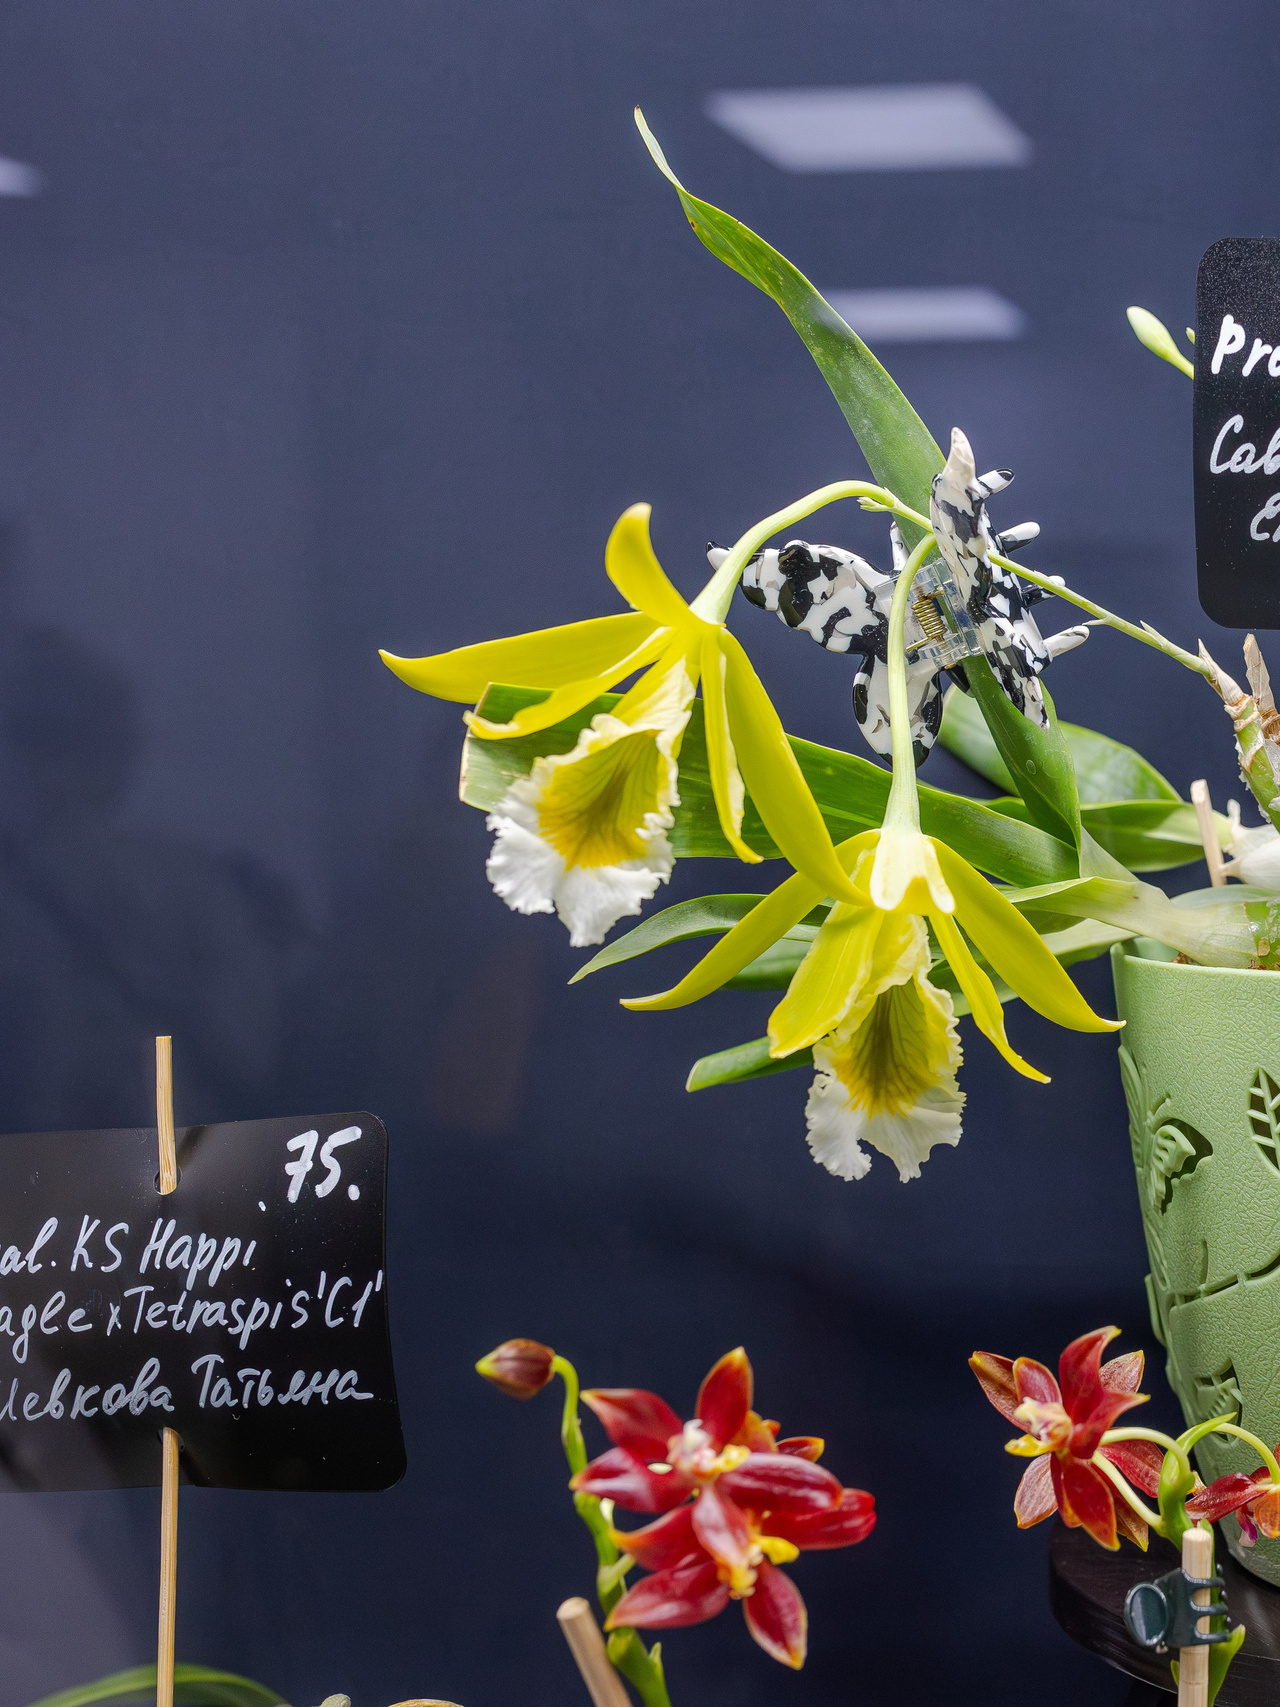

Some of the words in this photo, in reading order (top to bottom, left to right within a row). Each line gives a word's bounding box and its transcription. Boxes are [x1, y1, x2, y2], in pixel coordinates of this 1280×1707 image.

[0, 1216, 58, 1276] al.
[70, 1214, 130, 1273] KS
[138, 1201, 267, 1291] Happi
[190, 1353, 375, 1409] Татьяна
